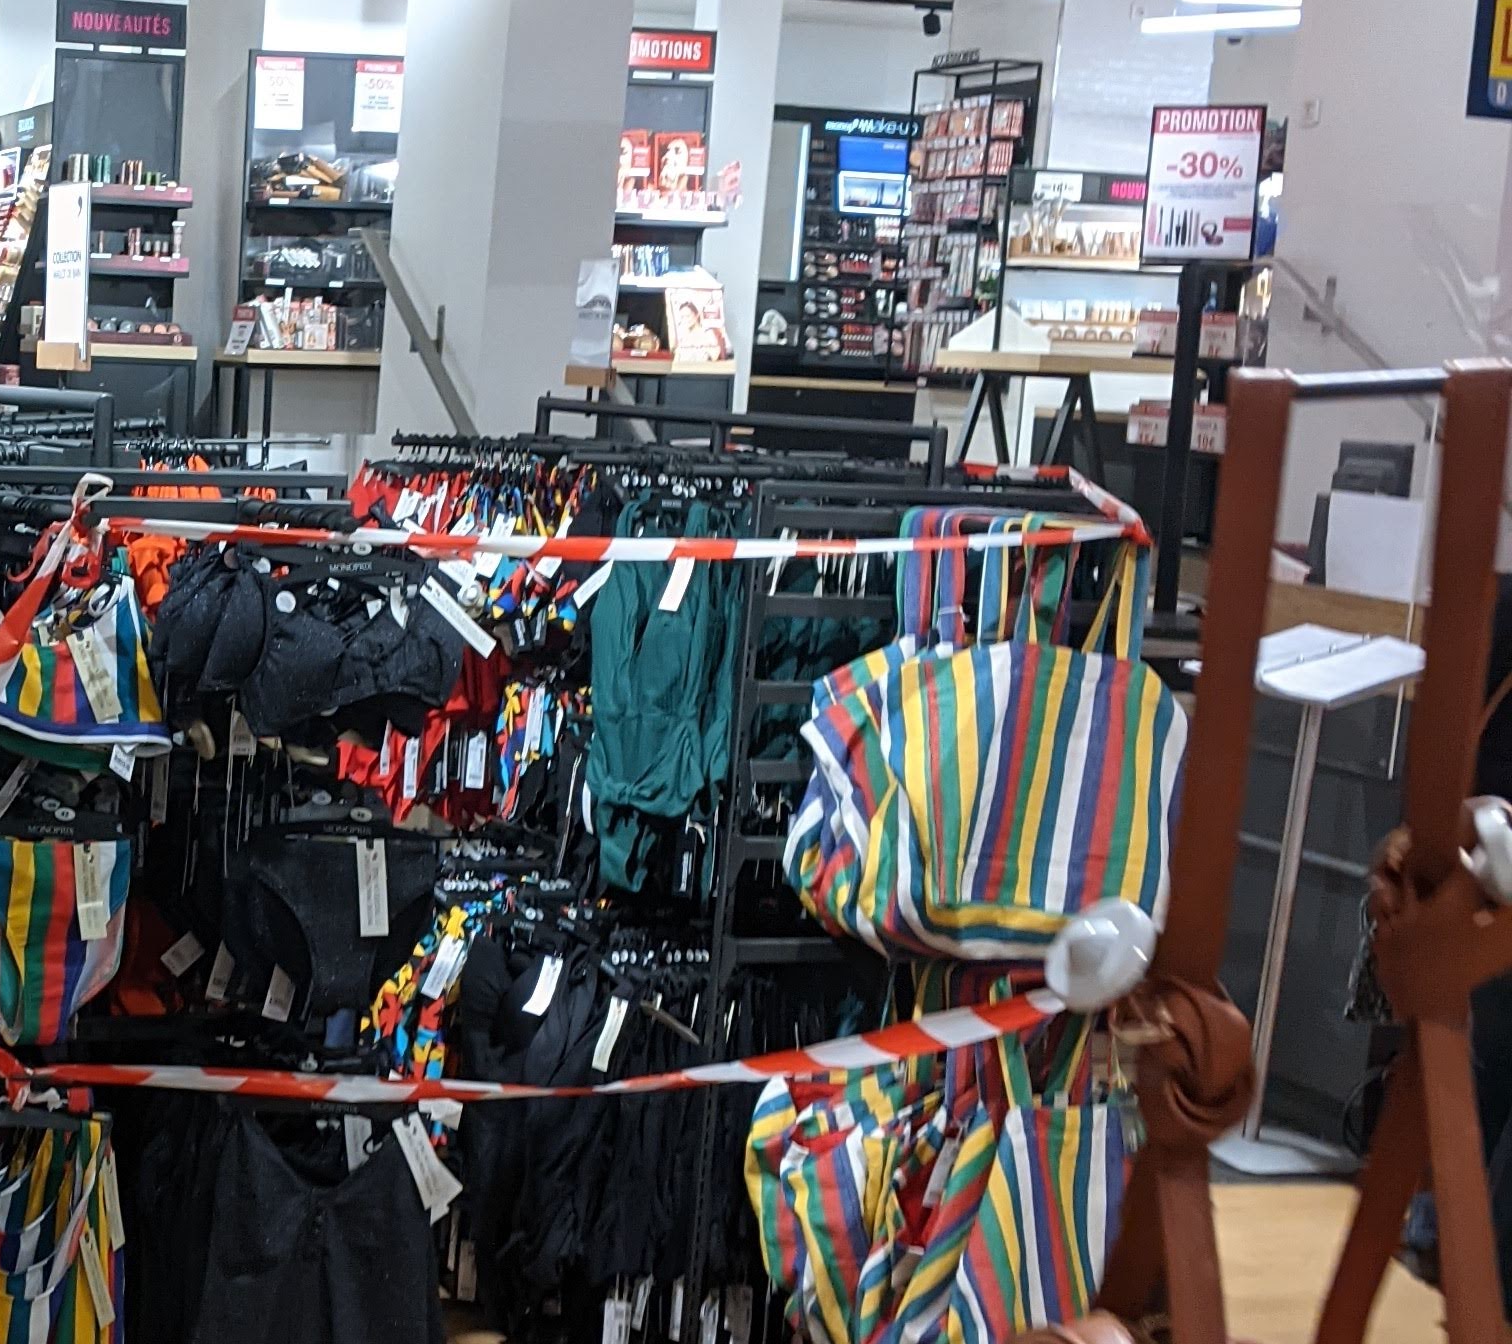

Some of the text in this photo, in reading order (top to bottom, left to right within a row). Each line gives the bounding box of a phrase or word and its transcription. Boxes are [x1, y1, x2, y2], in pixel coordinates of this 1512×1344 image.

[71, 10, 172, 36] NOUVEAUTÉS
[1158, 108, 1259, 133] PROMOTION
[1166, 150, 1244, 180] -30%
